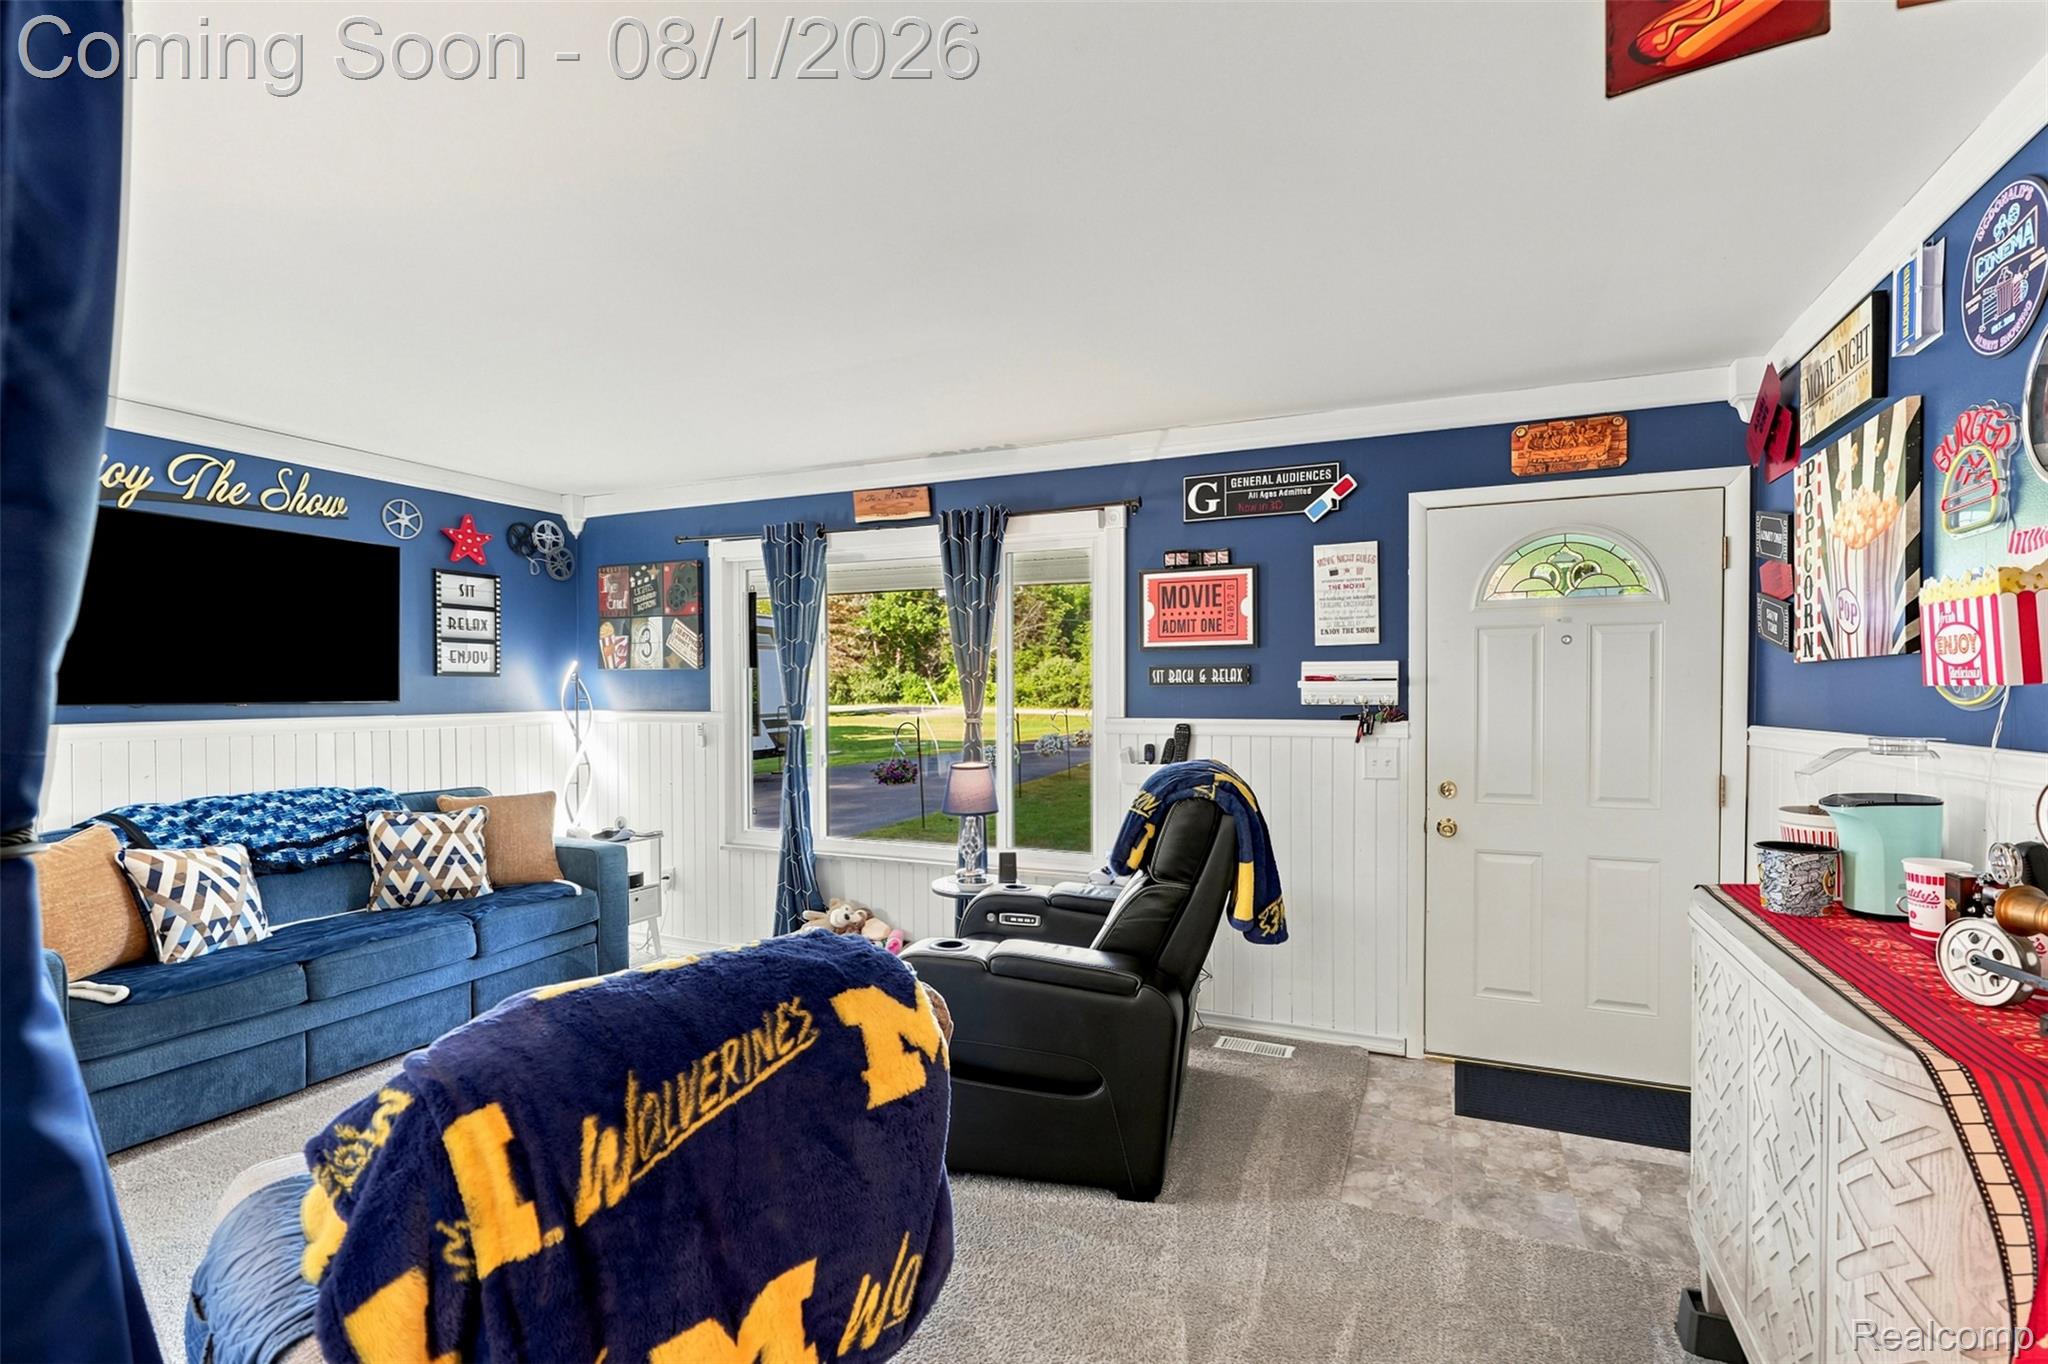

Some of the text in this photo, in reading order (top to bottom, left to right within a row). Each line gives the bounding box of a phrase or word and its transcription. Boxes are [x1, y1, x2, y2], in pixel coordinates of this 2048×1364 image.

[1975, 217, 2034, 283] CINEMA
[1804, 355, 1836, 405] MOVIE
[1837, 324, 1870, 379] NIGHT
[168, 453, 251, 505] The
[260, 468, 348, 517] Show
[1231, 469, 1332, 488] GENERAL AUDIENCES
[1187, 482, 1220, 514] G
[1260, 490, 1277, 499] Ages
[1279, 487, 1312, 497] Admitted
[1803, 459, 1815, 658] POPCORN
[459, 584, 475, 598] SIT
[1161, 584, 1222, 609] MOVIE
[1838, 596, 1858, 625] POP
[447, 616, 488, 632] RELAX
[1162, 618, 1222, 633] ADMIT ONE
[641, 628, 652, 658] 3
[1937, 633, 1977, 655] ENJOY
[448, 650, 488, 664] ENJOY
[1152, 668, 1243, 683] SIT BACK & RELAX
[574, 997, 819, 1227] WOLVERINES
